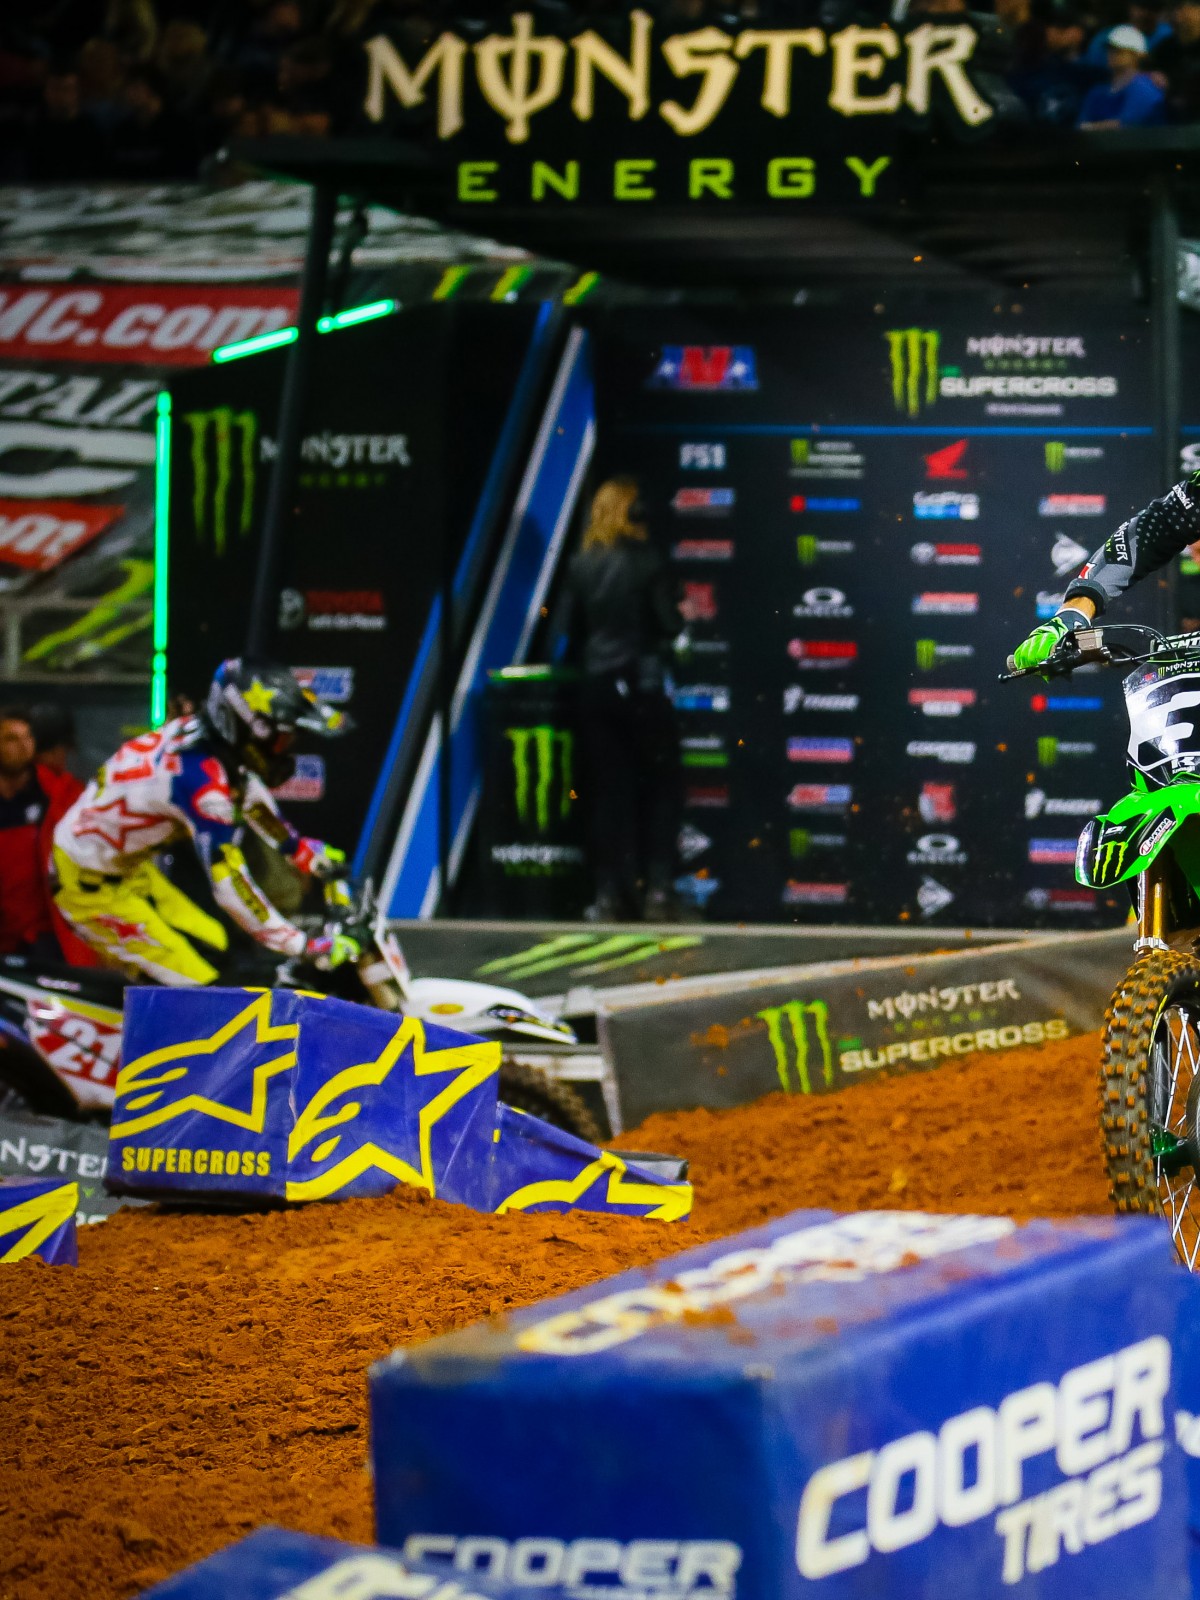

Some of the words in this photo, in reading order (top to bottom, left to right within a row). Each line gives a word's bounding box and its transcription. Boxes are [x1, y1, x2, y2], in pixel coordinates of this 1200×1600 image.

[364, 9, 993, 144] MONSTER
[457, 156, 891, 201] ENERGY
[966, 334, 1086, 358] MONSTER
[940, 376, 1118, 398] SUPERCROSS
[260, 432, 412, 467] MNSTER
[867, 978, 1022, 1021] MONSTER
[839, 1018, 1069, 1073] SUPERCROSS
[121, 1146, 271, 1177] SUPERCROSS
[795, 1333, 1172, 1581] COOPER
[995, 1439, 1166, 1586] TIRES
